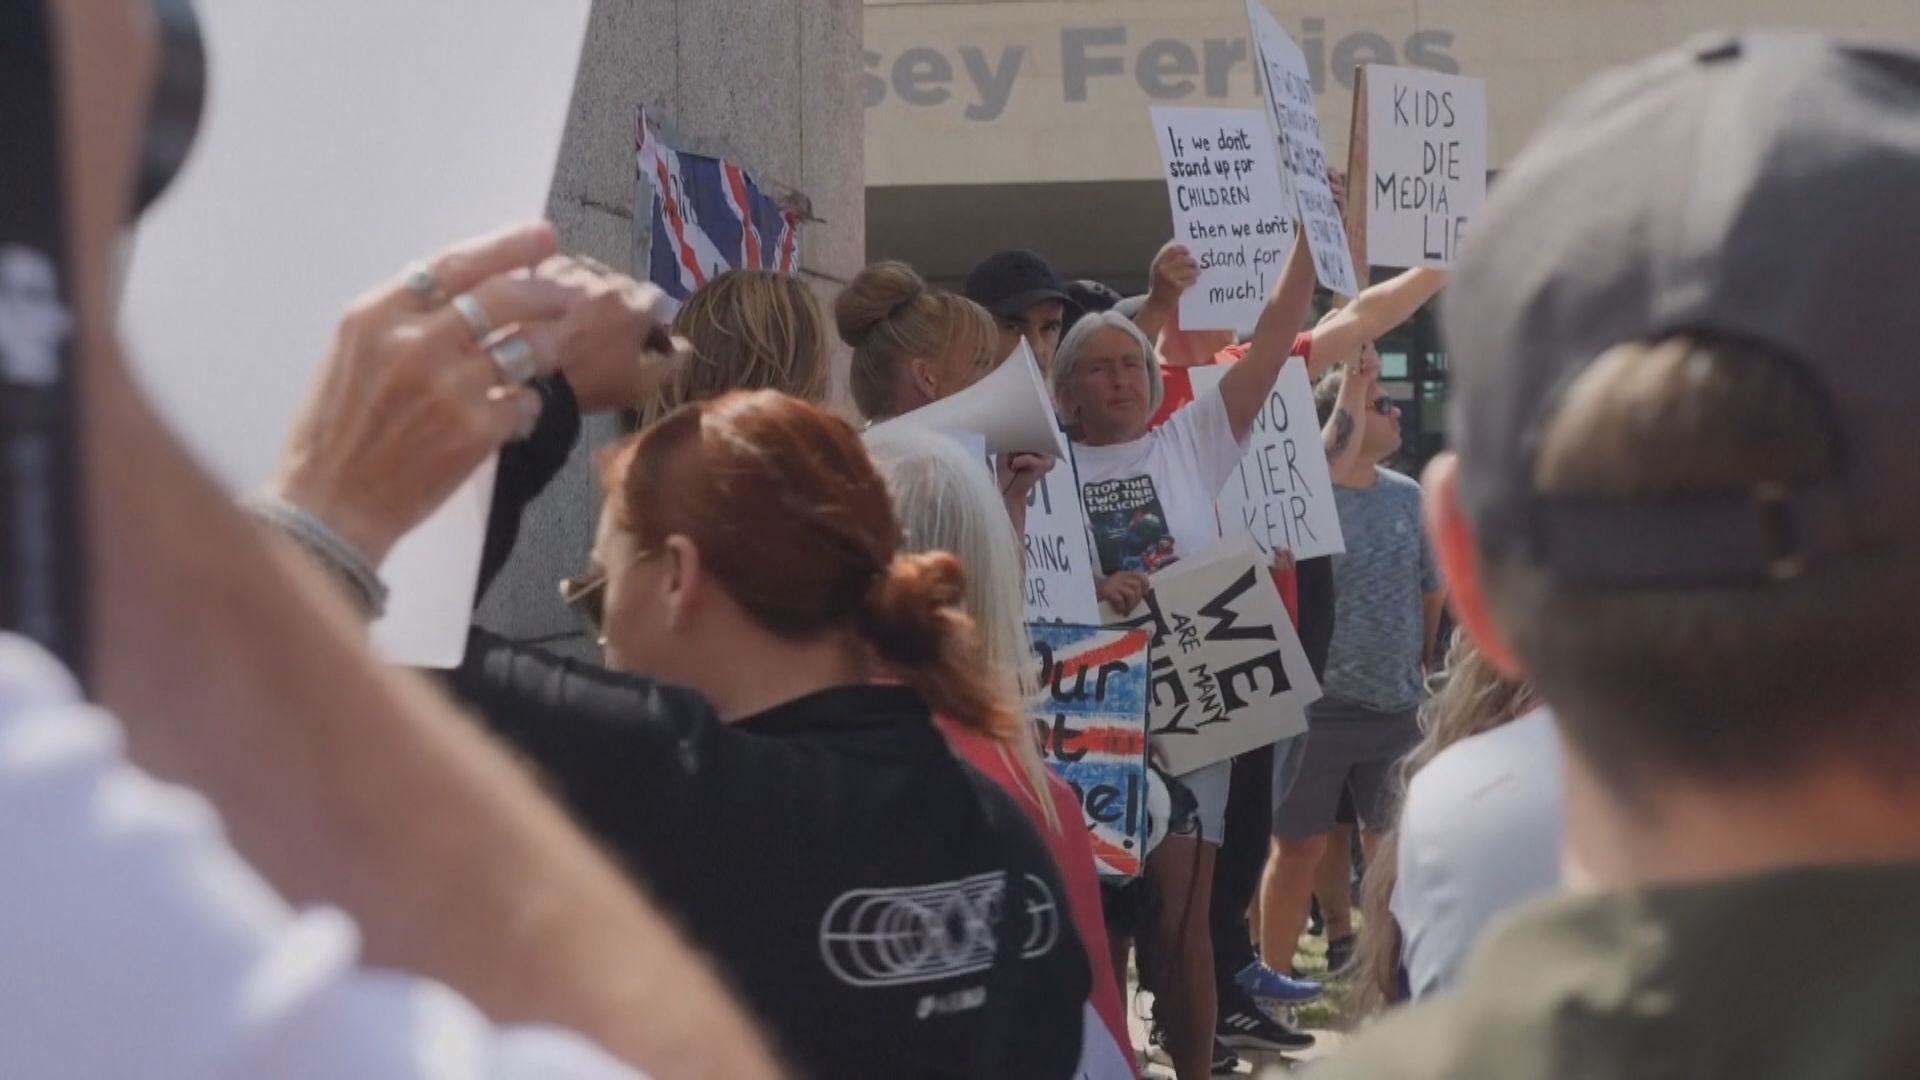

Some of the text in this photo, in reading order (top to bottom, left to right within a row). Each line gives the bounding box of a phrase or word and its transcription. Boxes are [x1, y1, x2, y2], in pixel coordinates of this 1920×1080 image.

[1060, 18, 1460, 101] Feries
[1394, 83, 1455, 127] KIDS
[1168, 126, 1251, 157] If we don't
[1170, 157, 1255, 181] stand up for
[1423, 140, 1460, 181] DIE
[1177, 185, 1250, 212] CHILDREN
[1375, 172, 1449, 213] MEDIA
[1189, 215, 1288, 239] then we don't
[1200, 245, 1281, 276] stand for
[1209, 272, 1264, 304] much!
[1085, 478, 1150, 495] STOP THE
[1086, 488, 1153, 505] TWO TIER
[1242, 496, 1317, 554] KEIR
[1197, 564, 1292, 715] WE
[1170, 612, 1231, 727] ARE MANY
